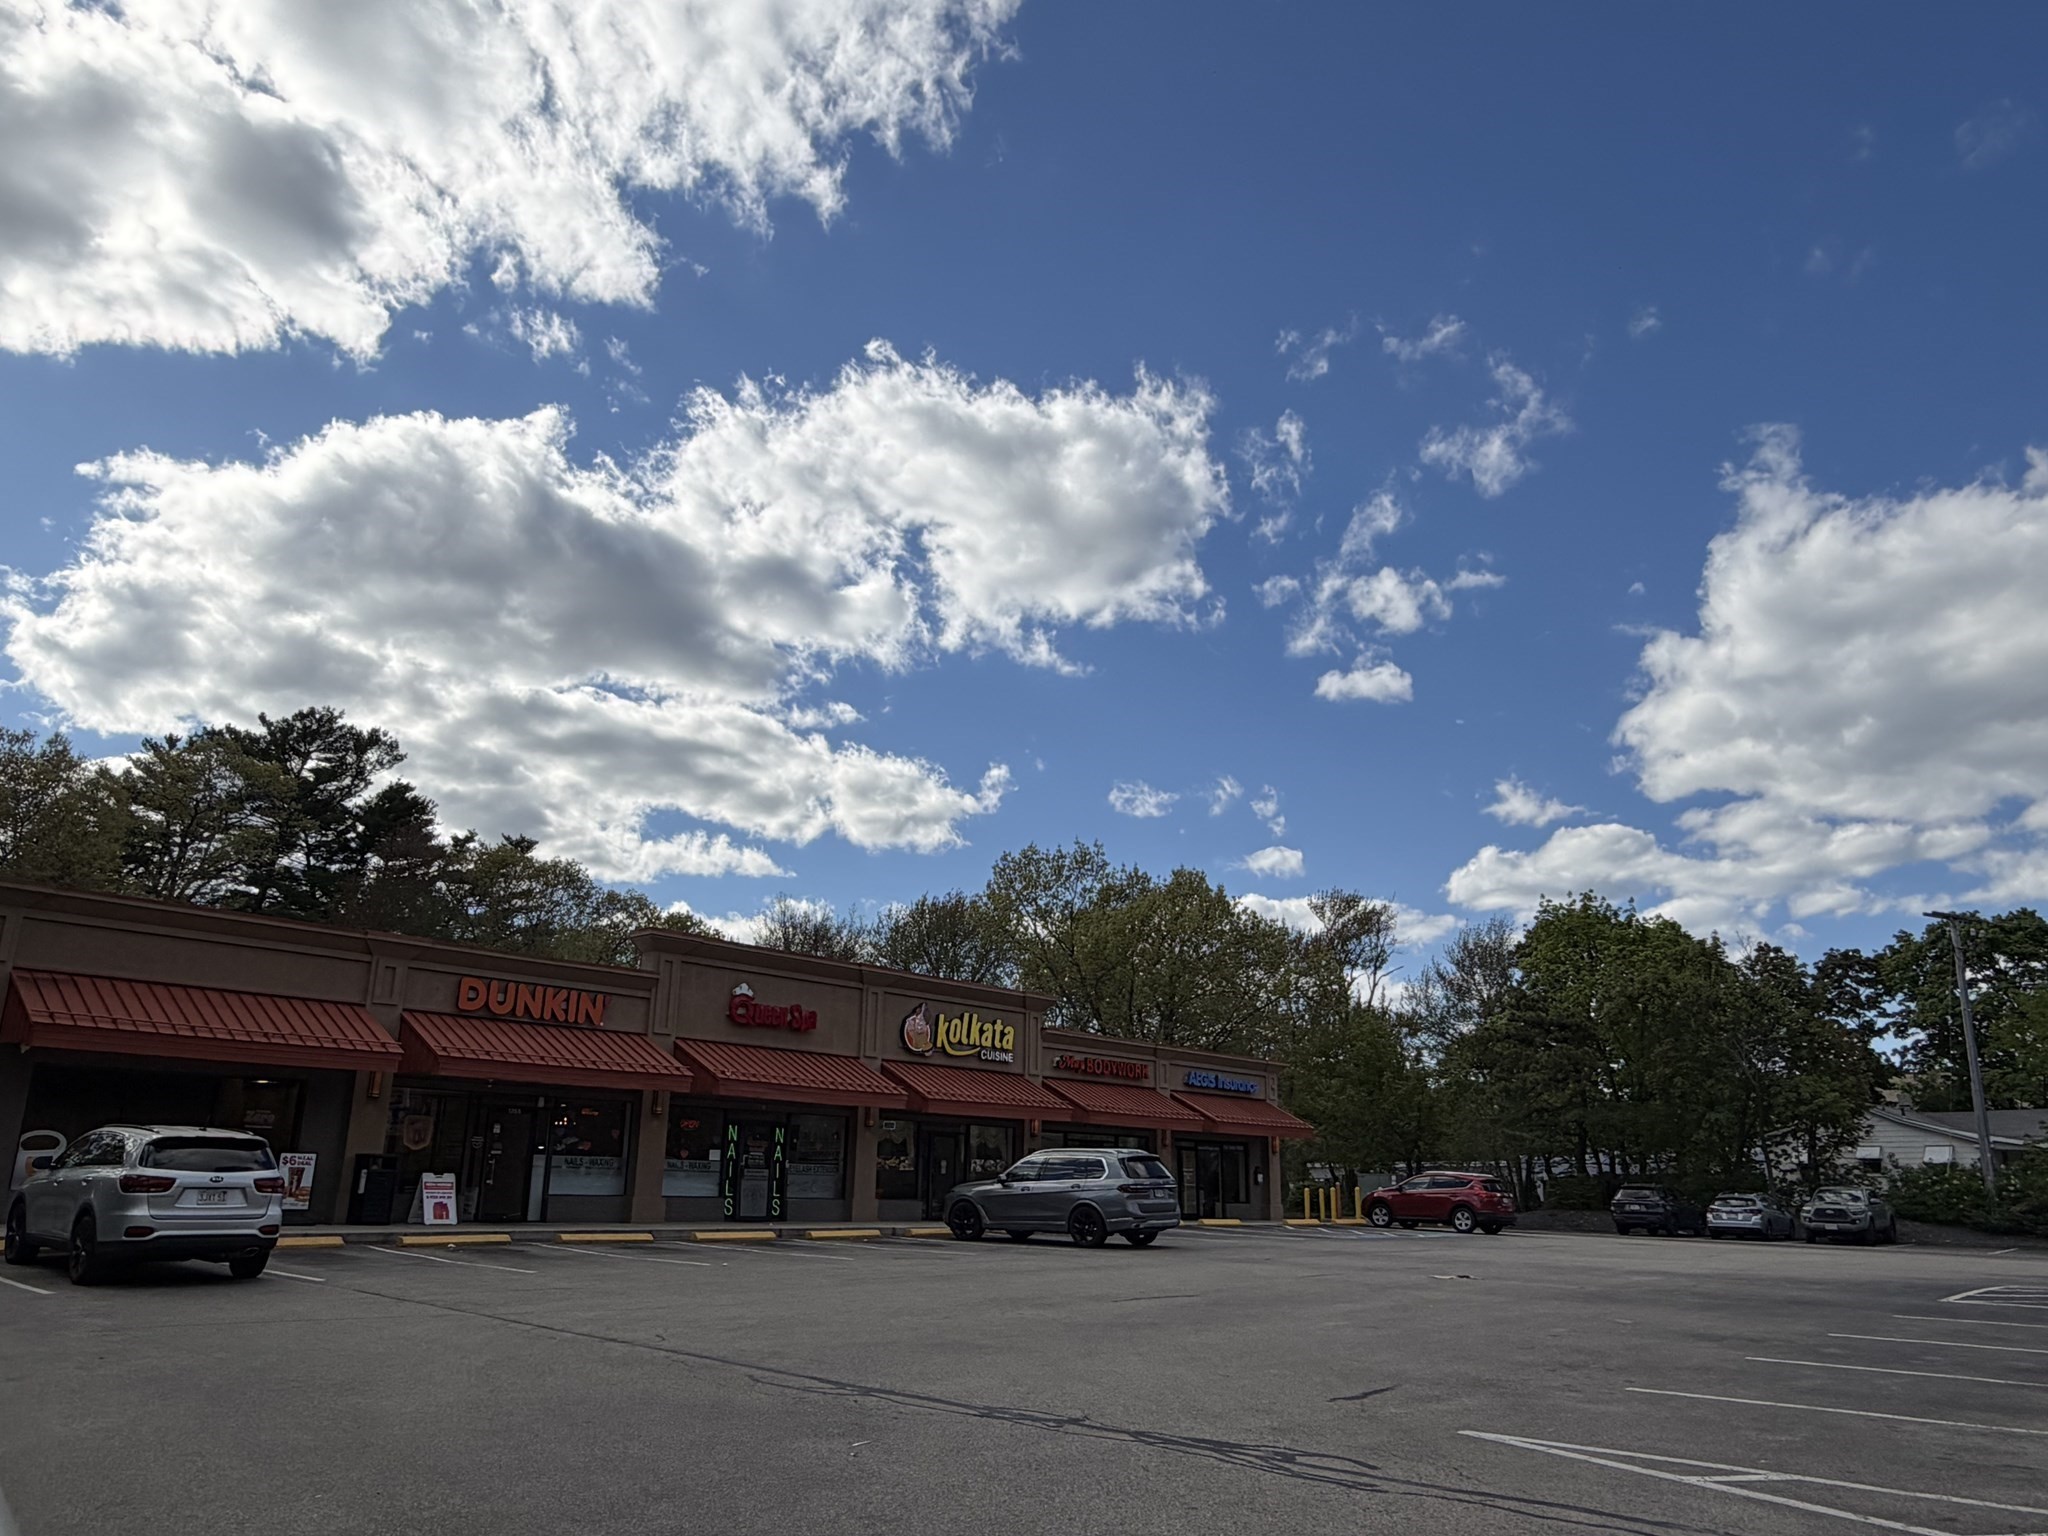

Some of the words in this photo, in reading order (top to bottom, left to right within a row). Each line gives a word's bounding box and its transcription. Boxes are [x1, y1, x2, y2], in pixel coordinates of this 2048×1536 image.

[981, 1050, 1014, 1062] CUISINE
[1189, 1071, 1216, 1088] AEGIS
[282, 1155, 297, 1166] $6
[724, 1124, 738, 1216] NAILS
[772, 1126, 786, 1216] NAILS
